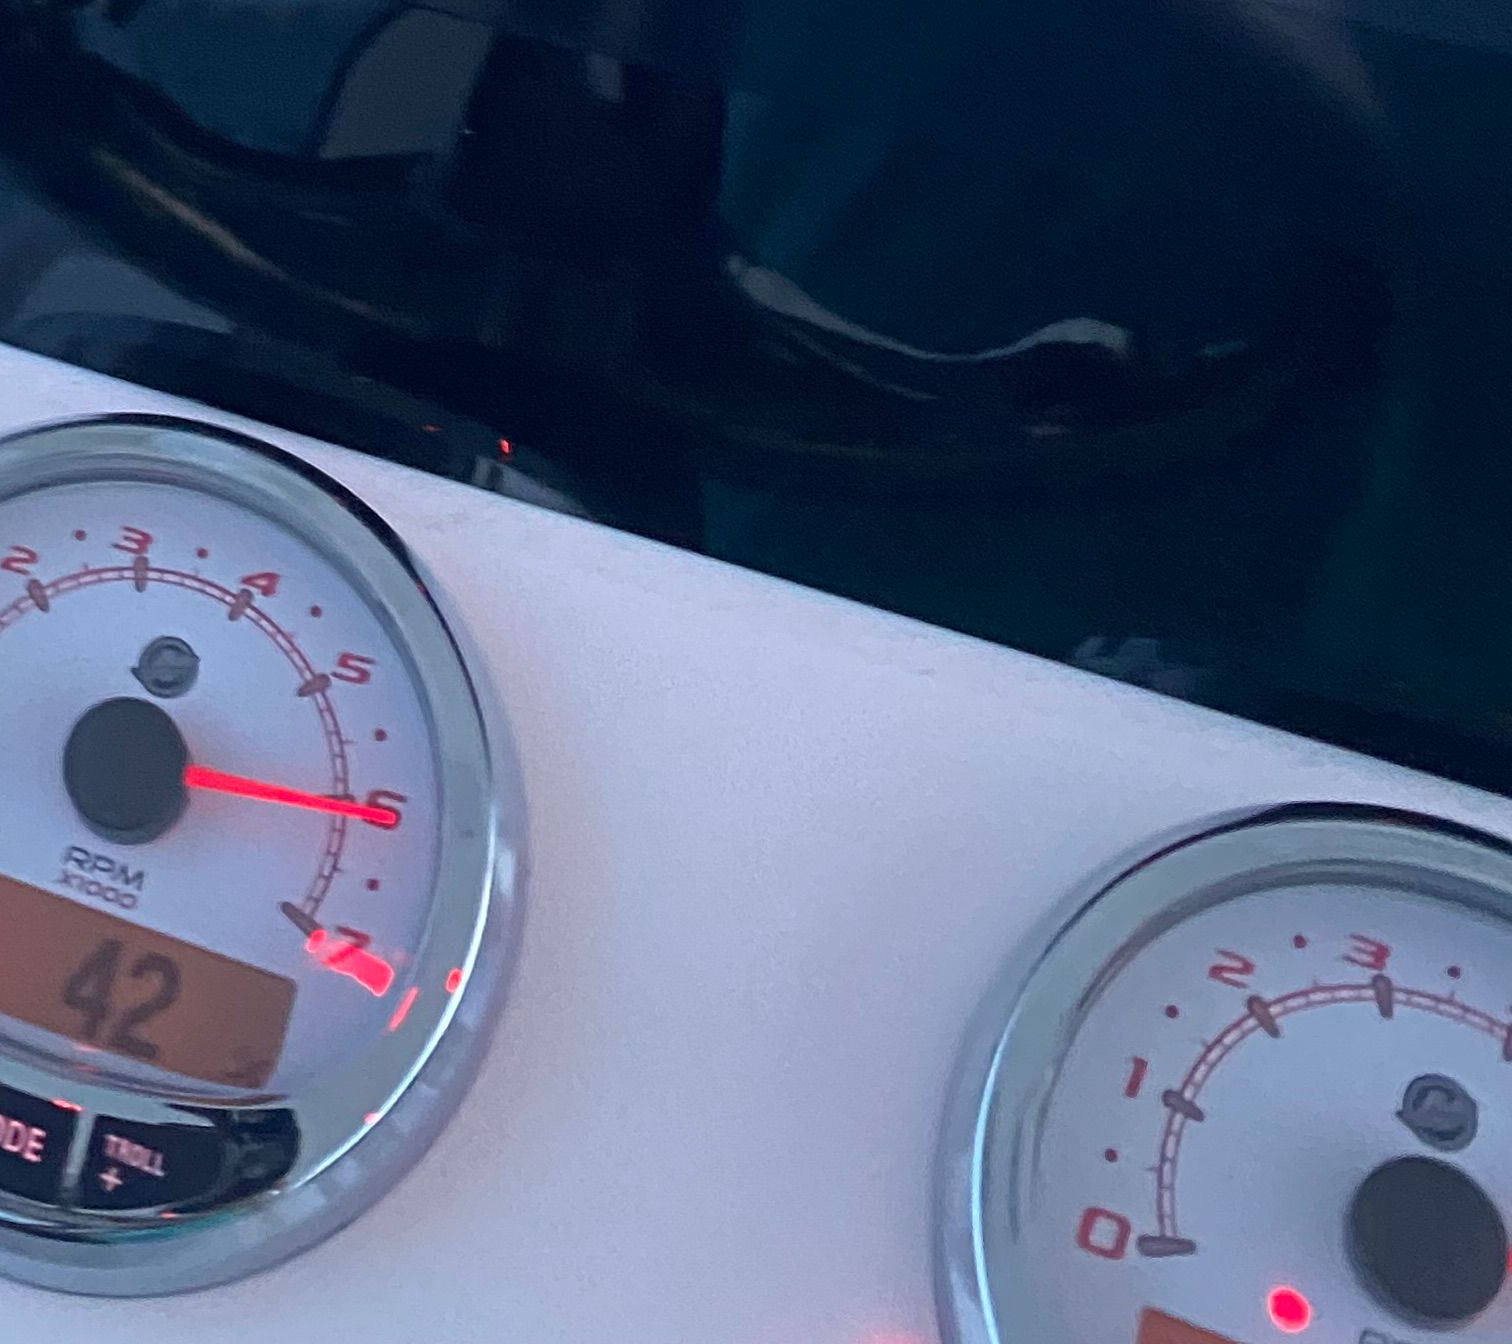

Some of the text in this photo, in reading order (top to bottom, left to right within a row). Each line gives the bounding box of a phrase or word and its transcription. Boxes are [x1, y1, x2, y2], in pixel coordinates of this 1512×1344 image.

[113, 526, 154, 555] 3
[241, 570, 280, 599] 4
[333, 652, 376, 685] 5
[63, 846, 145, 891] RPM
[1207, 949, 1255, 989] 2
[1341, 932, 1391, 971] 3
[61, 938, 182, 1059] 42
[1124, 1057, 1148, 1099] 1
[103, 1134, 165, 1177] TROLL
[1076, 1207, 1131, 1260] 0
